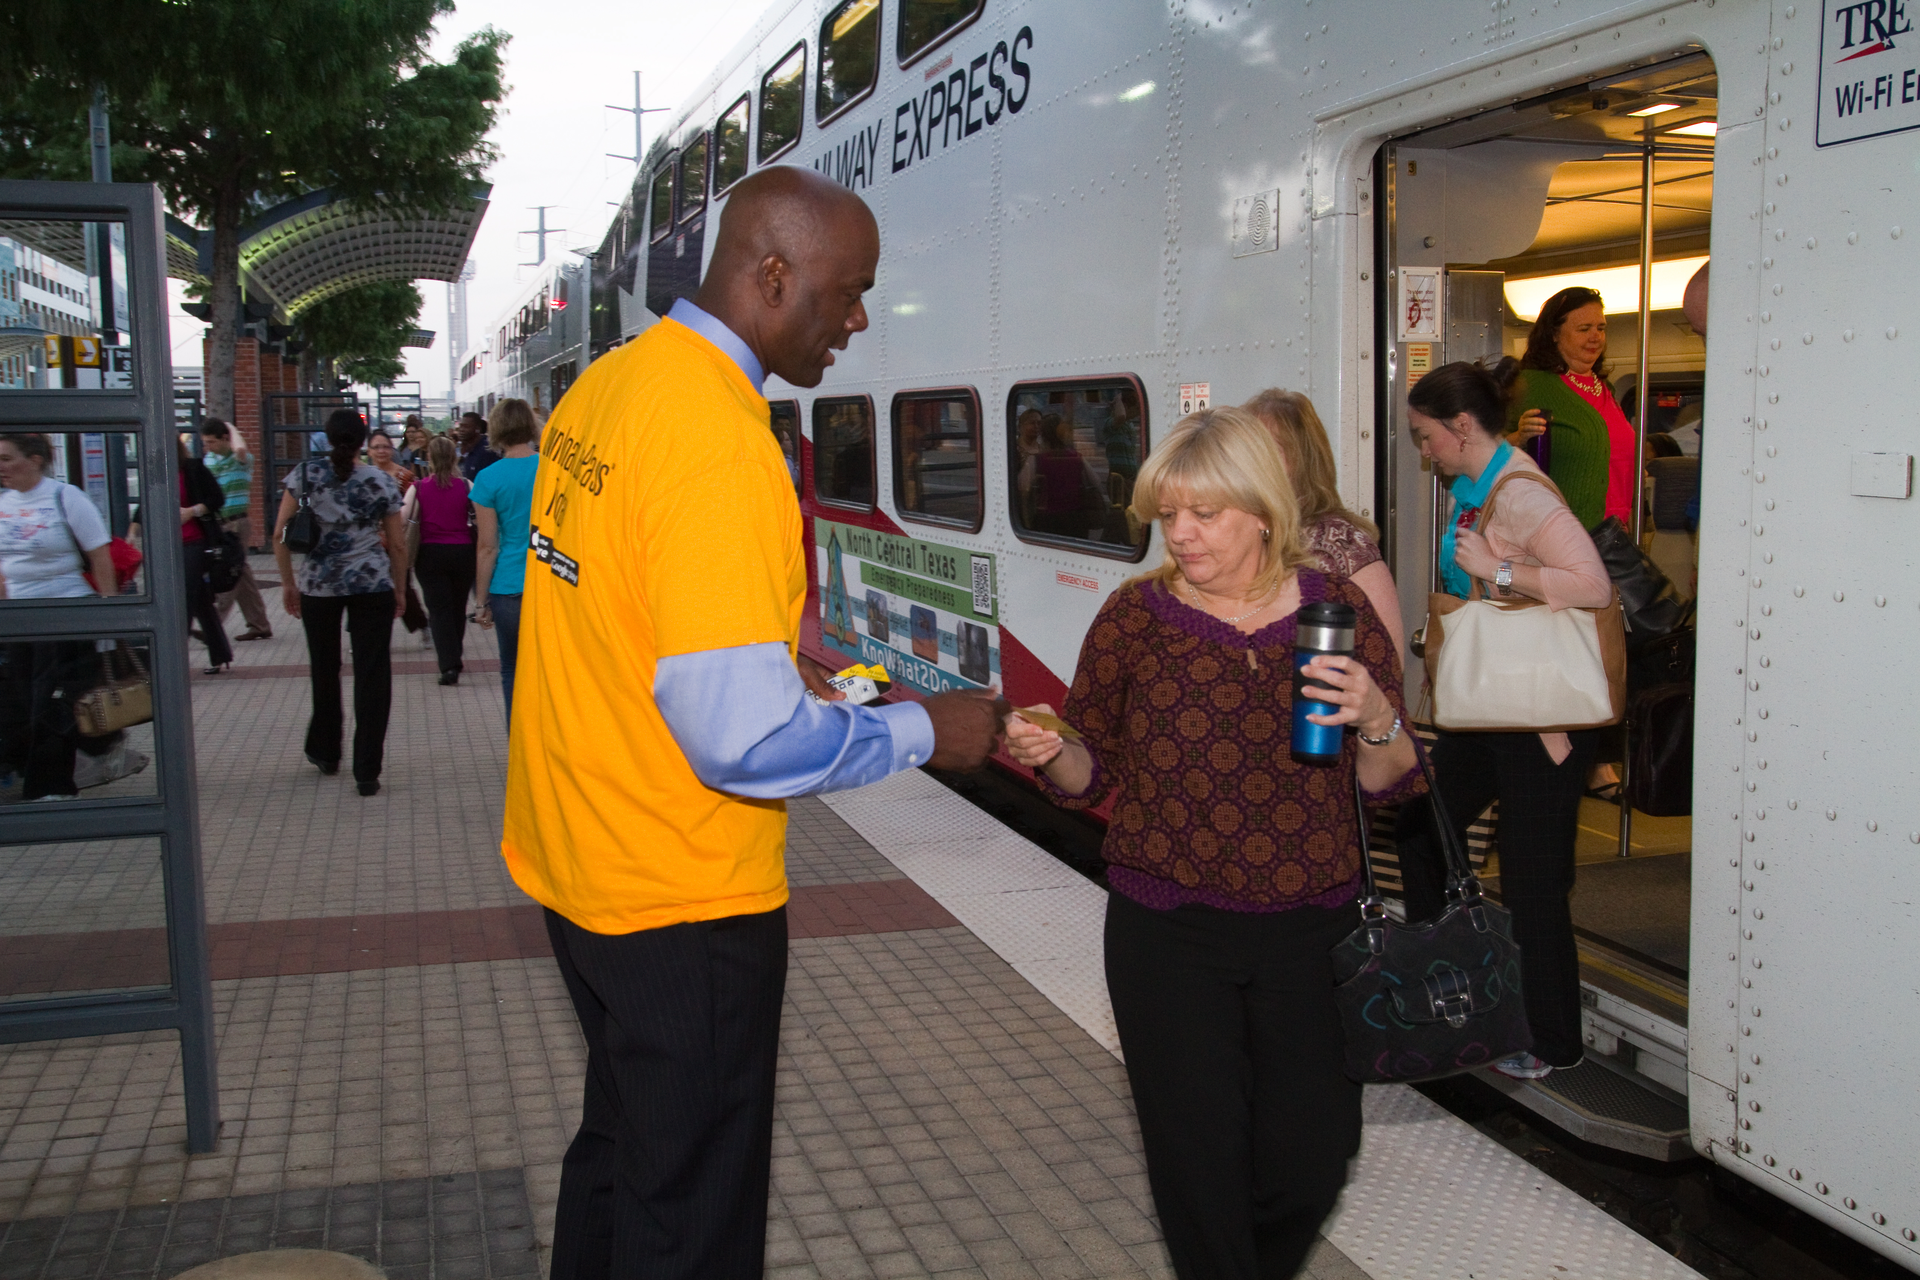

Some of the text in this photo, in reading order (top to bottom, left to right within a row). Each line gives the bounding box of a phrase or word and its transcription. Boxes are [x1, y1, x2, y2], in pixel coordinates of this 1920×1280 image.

[892, 25, 1033, 174] EXPRESS
[1835, 73, 1893, 118] Wi-Fi
[846, 527, 957, 581] North Central Texas
